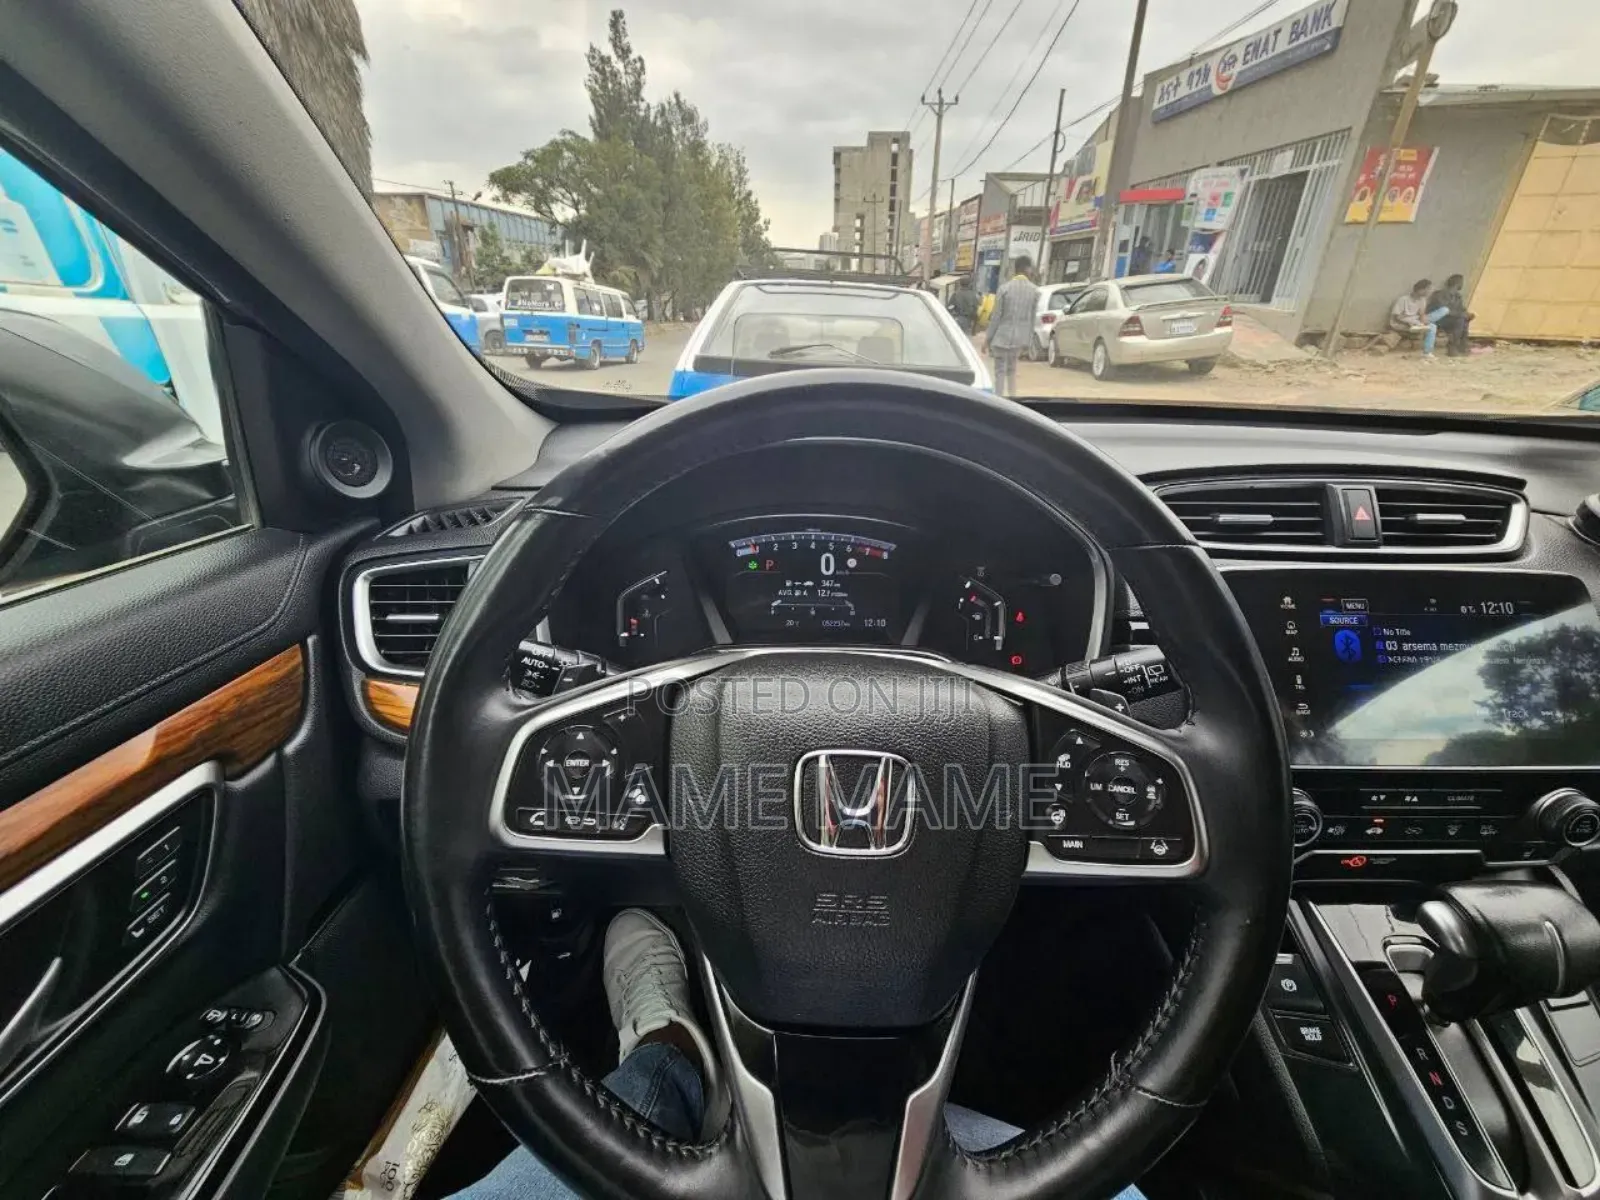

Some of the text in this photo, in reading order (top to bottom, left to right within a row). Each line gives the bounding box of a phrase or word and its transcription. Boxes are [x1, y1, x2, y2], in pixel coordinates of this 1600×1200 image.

[1242, 27, 1282, 66] ENAT
[1288, 0, 1337, 46] BANK
[766, 560, 774, 571] P
[820, 552, 835, 576] 0
[1480, 601, 1514, 615] 12:10
[864, 619, 886, 627] 12:10
[1330, 616, 1359, 625] SOURCE
[1383, 628, 1394, 636] No
[1385, 641, 1398, 651] 03
[1402, 642, 1437, 652] arsema
[521, 656, 545, 669] AUTO
[565, 759, 590, 768] ENTER
[1114, 758, 1130, 767] RES
[1107, 783, 1137, 795] CANCEL
[1115, 812, 1130, 821] SET
[1062, 839, 1084, 849] MAIN
[1300, 1026, 1322, 1035] BRAKE
[1304, 1033, 1322, 1041] HOLD
[1416, 1047, 1430, 1061] R
[1429, 1071, 1444, 1087] N
[1443, 1096, 1455, 1110] D
[1455, 1121, 1468, 1136] S
